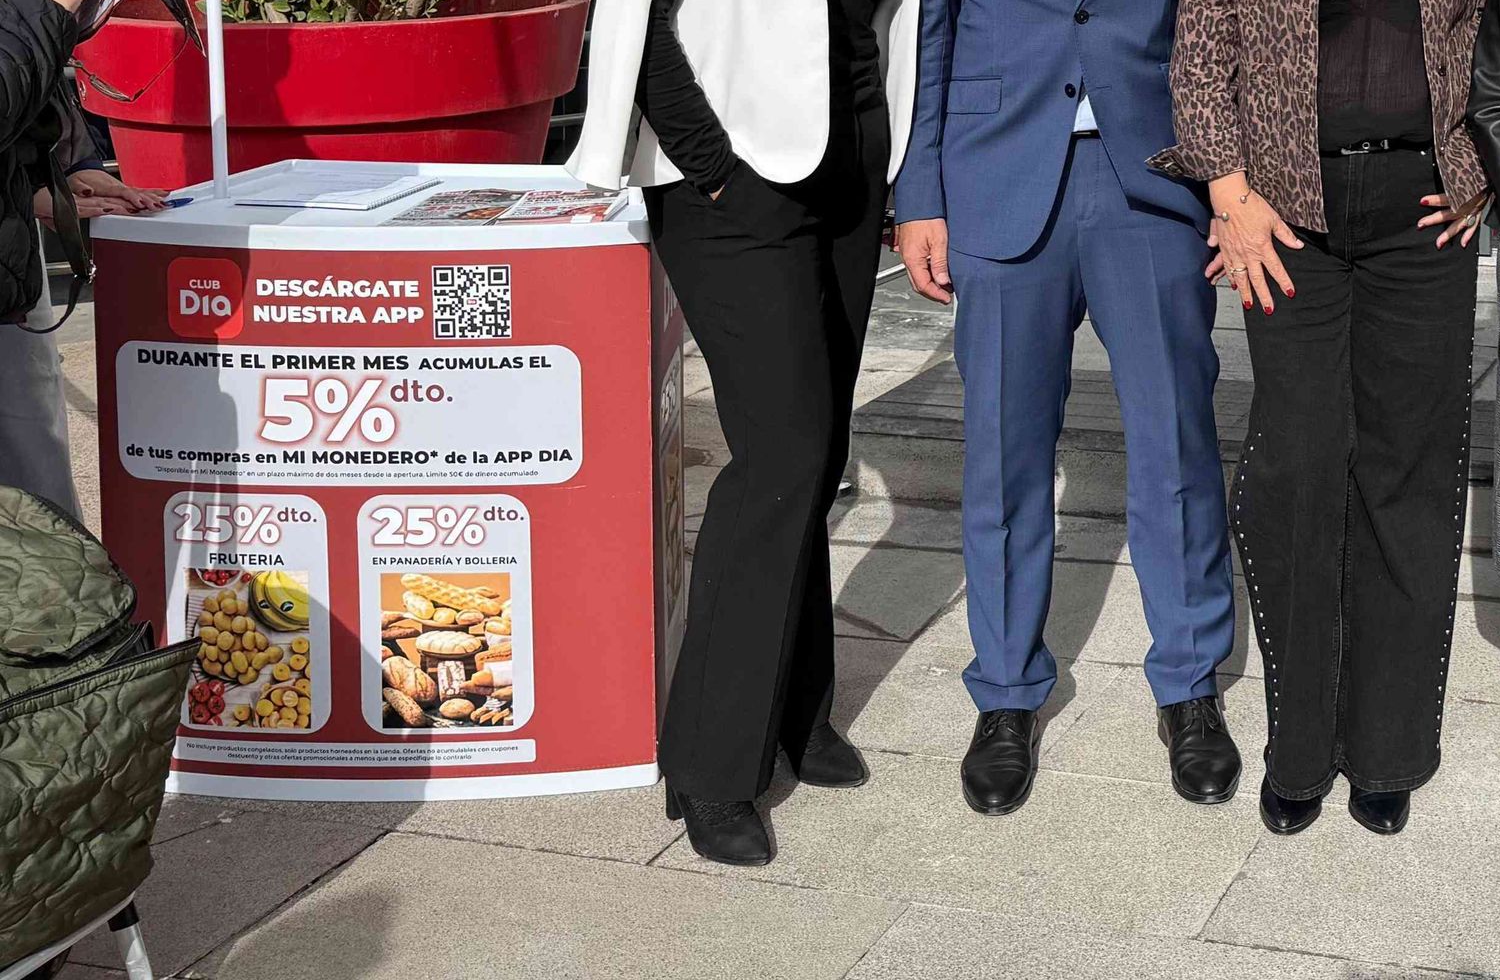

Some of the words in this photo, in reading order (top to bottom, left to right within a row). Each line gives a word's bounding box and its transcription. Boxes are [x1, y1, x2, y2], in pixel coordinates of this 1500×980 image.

[189, 278, 221, 290] CLUB
[255, 275, 420, 298] DESCÁRGATE
[253, 305, 369, 324] NUESTRA
[372, 306, 425, 324] APP
[137, 348, 234, 368] DURANTE
[240, 354, 266, 369] EL
[272, 354, 356, 371] PRIMER
[363, 355, 410, 370] MES
[418, 356, 524, 370] ACUMULAS
[529, 356, 552, 368] EL
[259, 376, 397, 445] 5%
[390, 378, 454, 403] dto.
[126, 443, 144, 457] de
[148, 446, 173, 460] tus
[177, 451, 251, 465] compras
[255, 452, 277, 464] en
[282, 451, 306, 465] MI
[444, 451, 467, 465] de
[472, 451, 489, 464] la
[494, 450, 533, 464] APP
[538, 449, 573, 463] DIA
[267, 470, 286, 479] plazo
[286, 470, 315, 478] máximo
[326, 471, 339, 479] dos
[465, 470, 474, 478] de
[499, 469, 539, 477] acumulado
[173, 502, 281, 546] 25%
[277, 506, 318, 523] dto.
[371, 505, 486, 546] 25%
[483, 505, 525, 522] dto.
[208, 551, 285, 567] FRUTERIA
[372, 556, 387, 565] EN
[390, 554, 453, 566] PANADERÍA
[454, 556, 463, 565] Y
[465, 555, 517, 565] BOLLERIA
[186, 742, 195, 750] No
[196, 743, 216, 752] incluye
[217, 744, 247, 752] productos
[298, 747, 329, 755] productos
[491, 745, 518, 753] cupones
[281, 753, 302, 762] ofertas
[302, 754, 349, 763] promocionales
[376, 755, 389, 763] que
[442, 753, 472, 761] contrario
